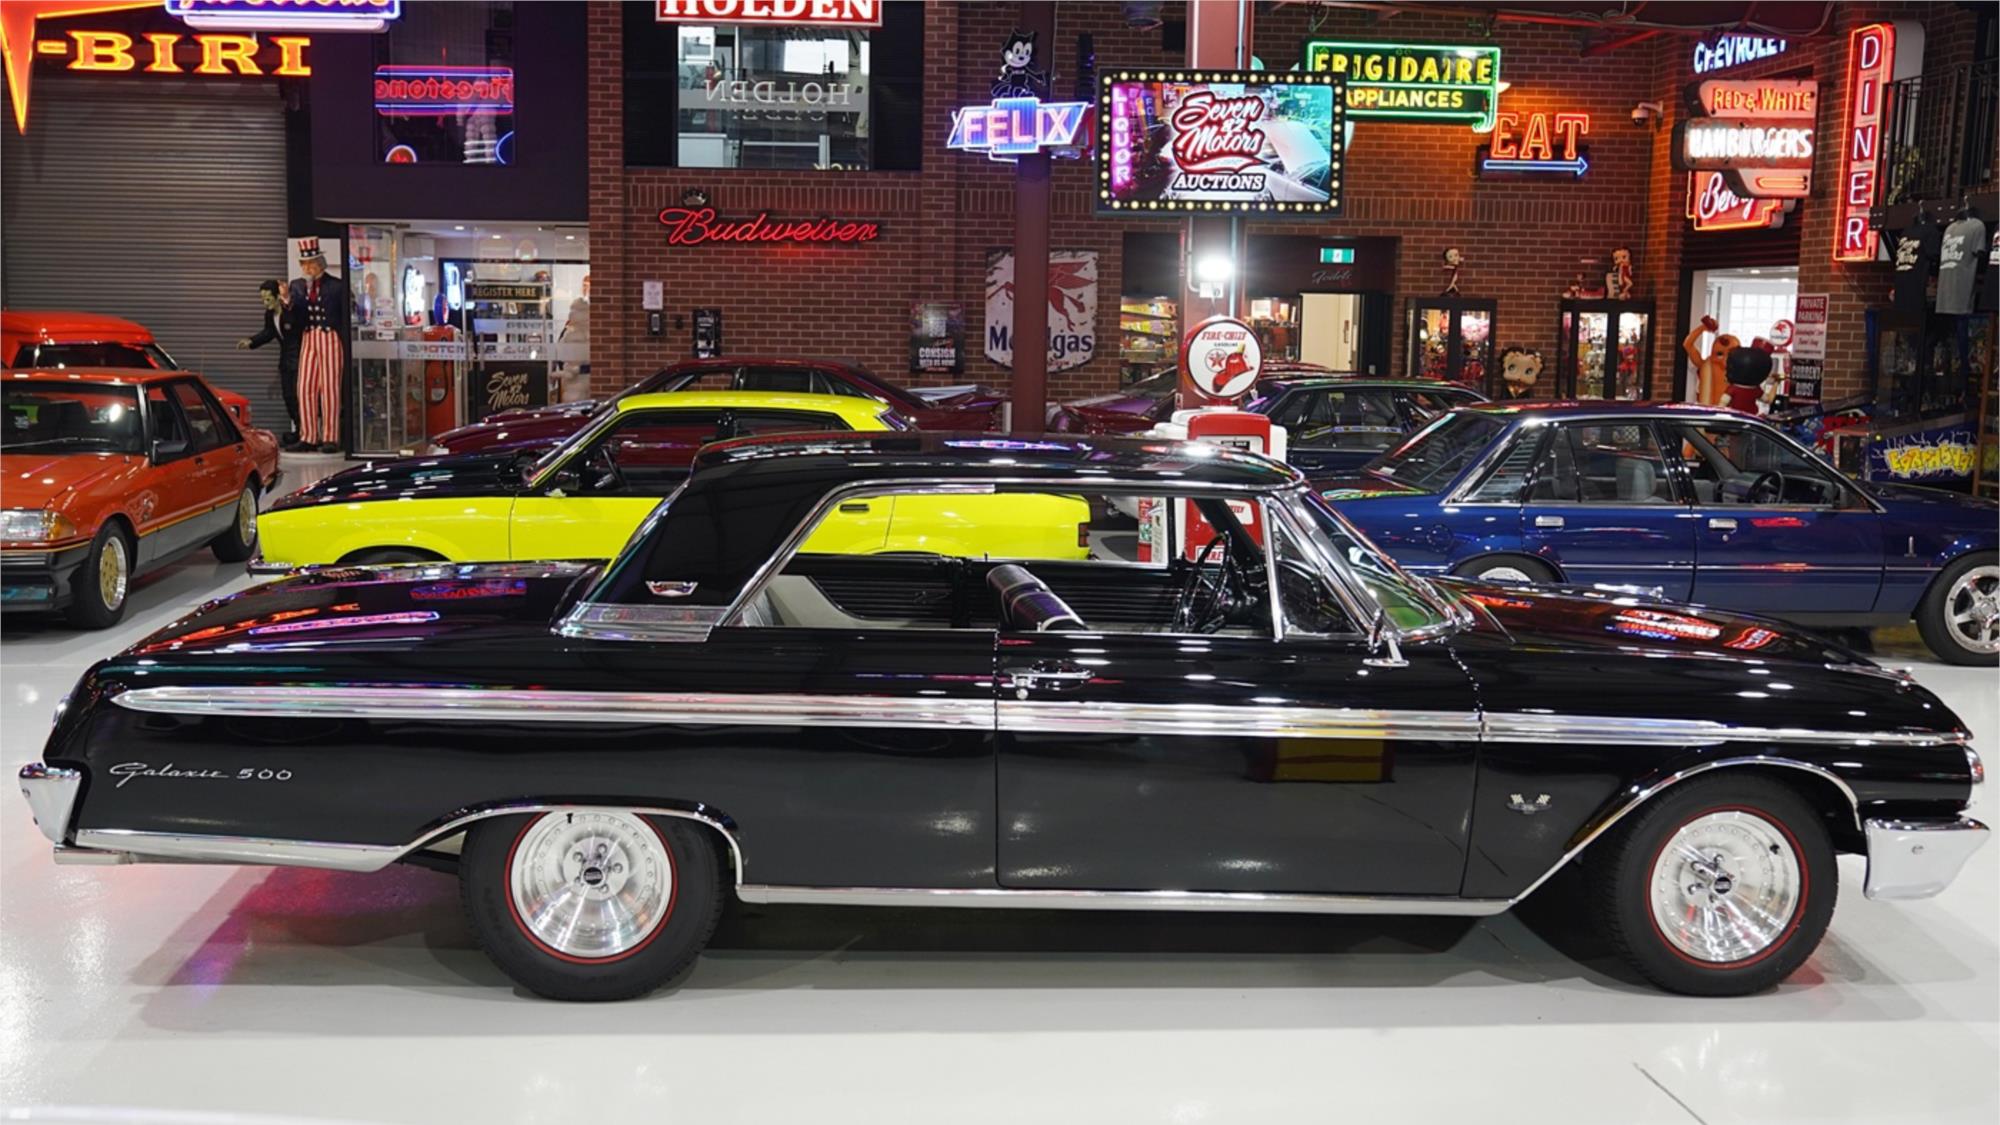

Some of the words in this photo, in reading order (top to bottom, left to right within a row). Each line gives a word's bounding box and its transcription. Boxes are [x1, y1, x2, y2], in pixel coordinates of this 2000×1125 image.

[1314, 53, 1492, 84] FRIGIDAIRE
[1175, 93, 1260, 130] Seven
[1713, 87, 1741, 109] RED
[1760, 87, 1811, 111] WHITE
[963, 108, 1071, 145] FELIX
[1112, 88, 1131, 184] LIQUOR
[1176, 125, 1262, 160] Motors
[1491, 112, 1589, 160] EAT
[1689, 127, 1813, 158] HAMBURGERS
[1845, 35, 1880, 250] DINER
[1173, 173, 1263, 190] AUCTIONS
[659, 207, 878, 245] Budweiser
[473, 286, 512, 297] REGISTER
[514, 286, 536, 297] HERE
[109, 762, 229, 788] Galaxie
[236, 768, 292, 781] 500
